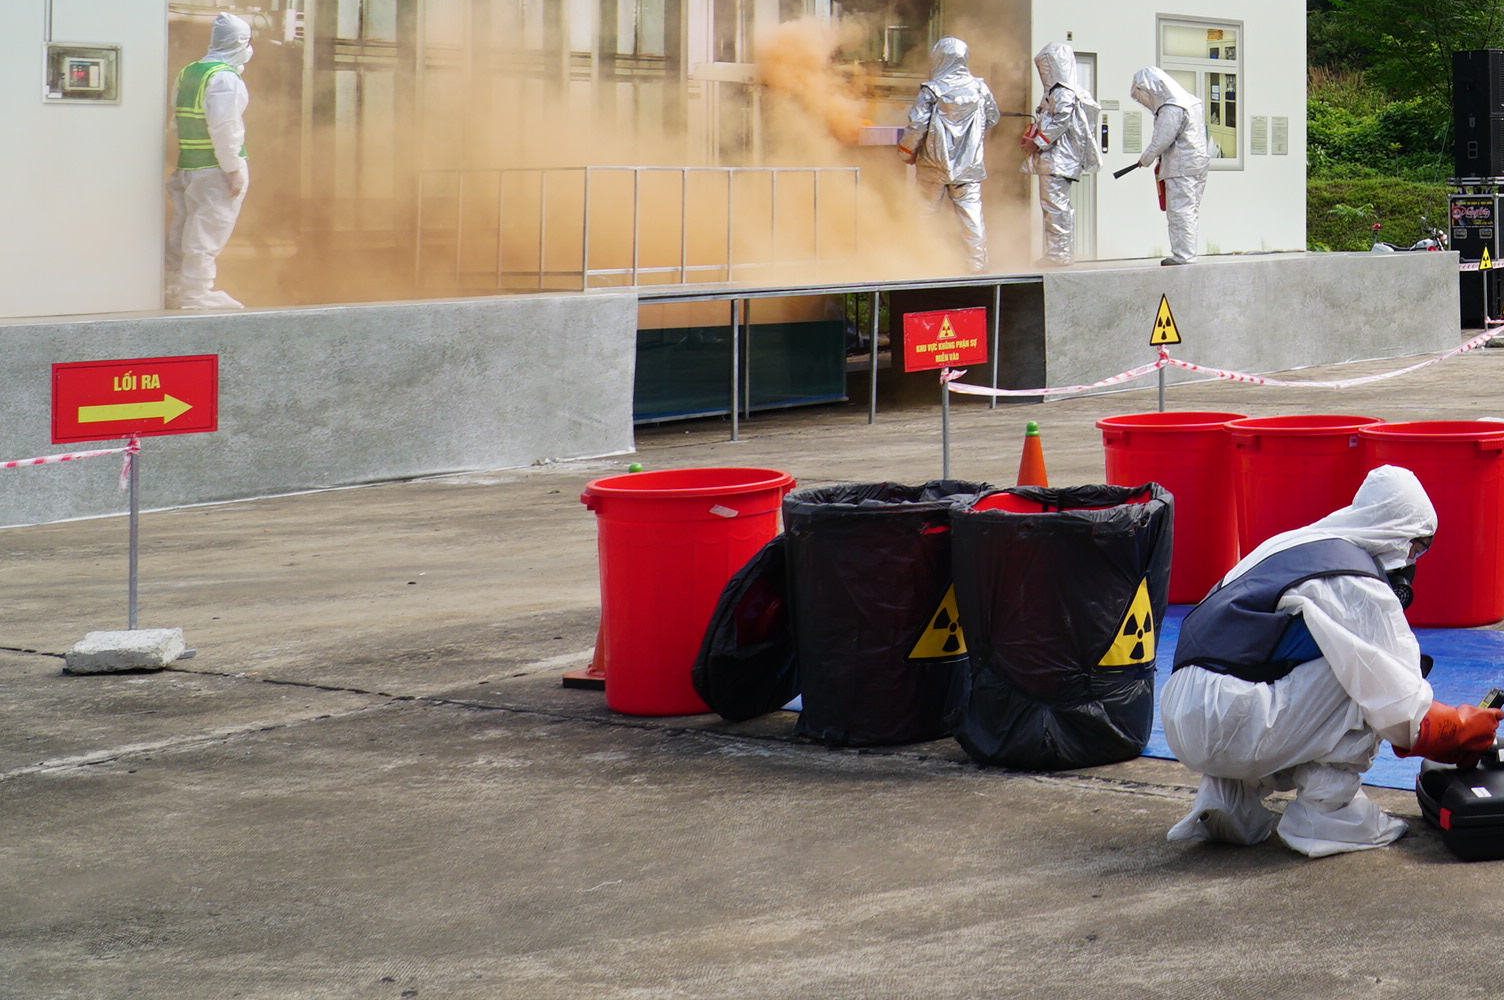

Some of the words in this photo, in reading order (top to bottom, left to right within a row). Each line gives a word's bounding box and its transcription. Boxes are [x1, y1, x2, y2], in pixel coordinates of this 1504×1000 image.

[916, 344, 927, 353] KHU
[113, 370, 137, 392] LỐI
[141, 374, 161, 390] RA
